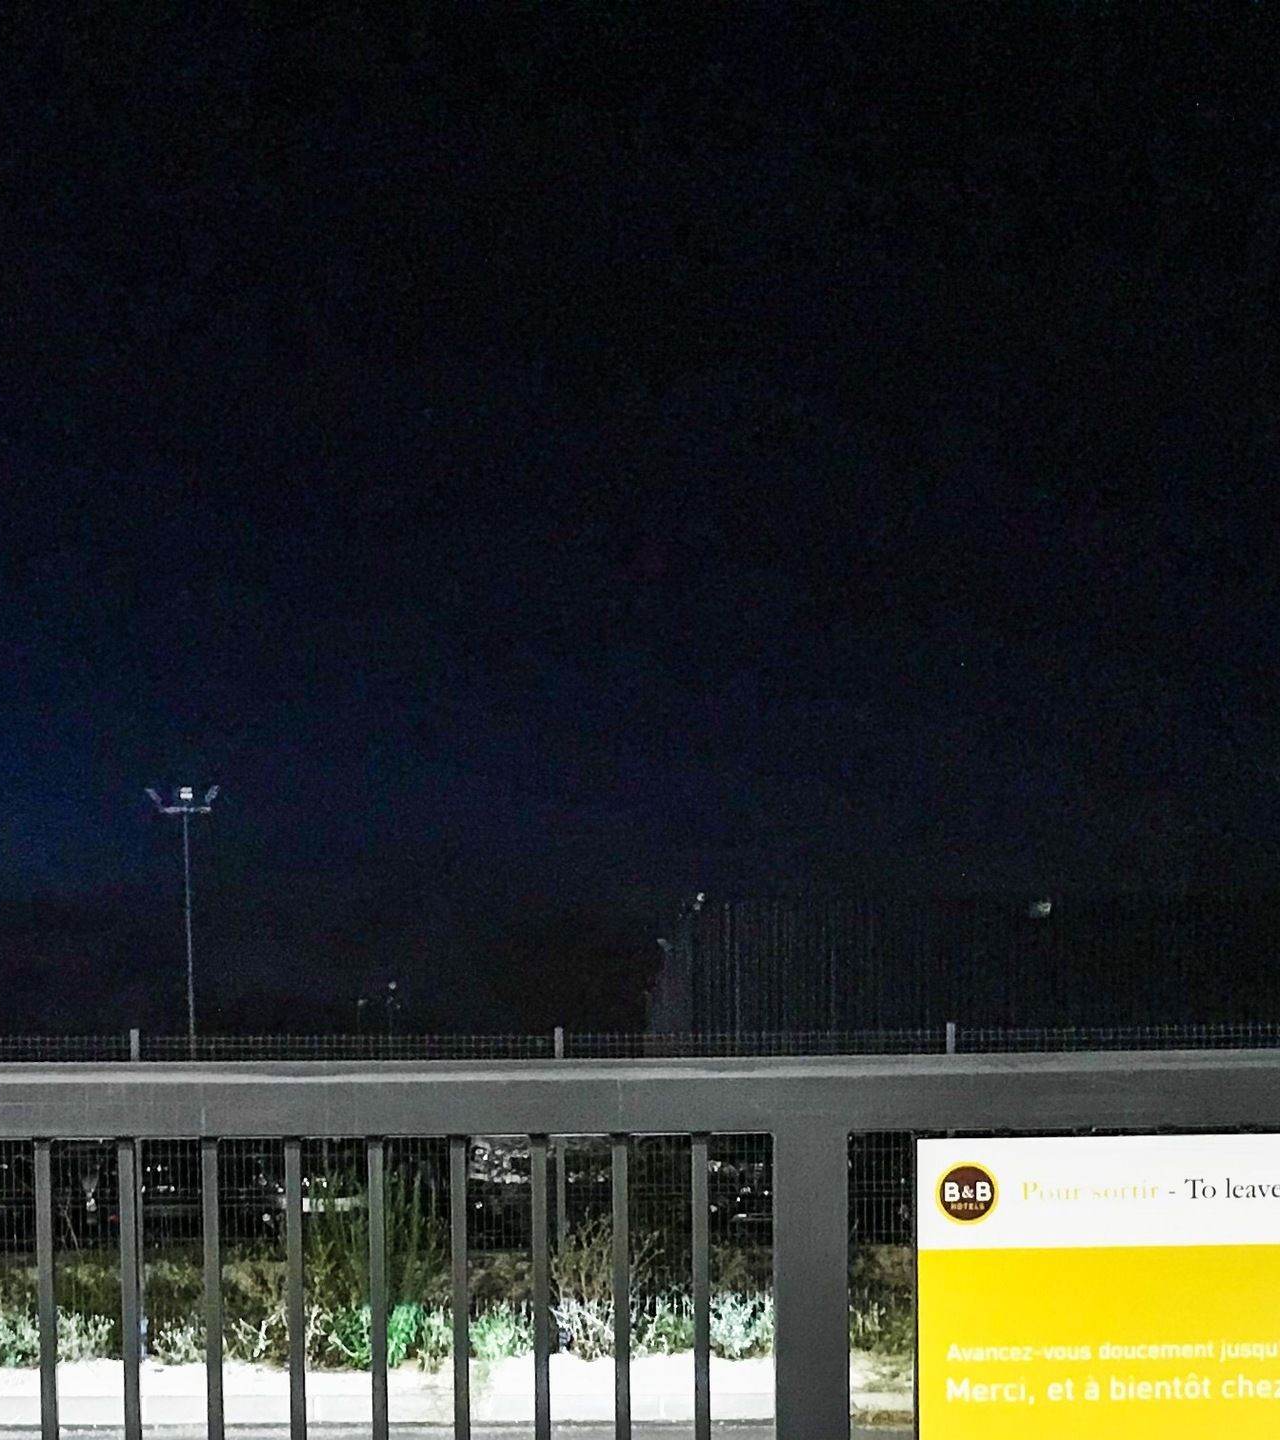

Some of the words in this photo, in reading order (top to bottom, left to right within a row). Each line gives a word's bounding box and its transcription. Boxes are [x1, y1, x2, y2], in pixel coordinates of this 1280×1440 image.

[944, 1181, 992, 1202] B&B
[1022, 1181, 1080, 1201] Pour
[1092, 1179, 1158, 1200] sortir
[1183, 1177, 1217, 1200] To
[950, 1203, 986, 1211] HOTELS
[946, 1343, 1092, 1362] Avancez-vous
[1098, 1342, 1214, 1360] doucement
[946, 1377, 1035, 1405] Merci,
[1047, 1378, 1075, 1401] et
[1084, 1375, 1100, 1401] à
[1109, 1373, 1211, 1401] bientôt
